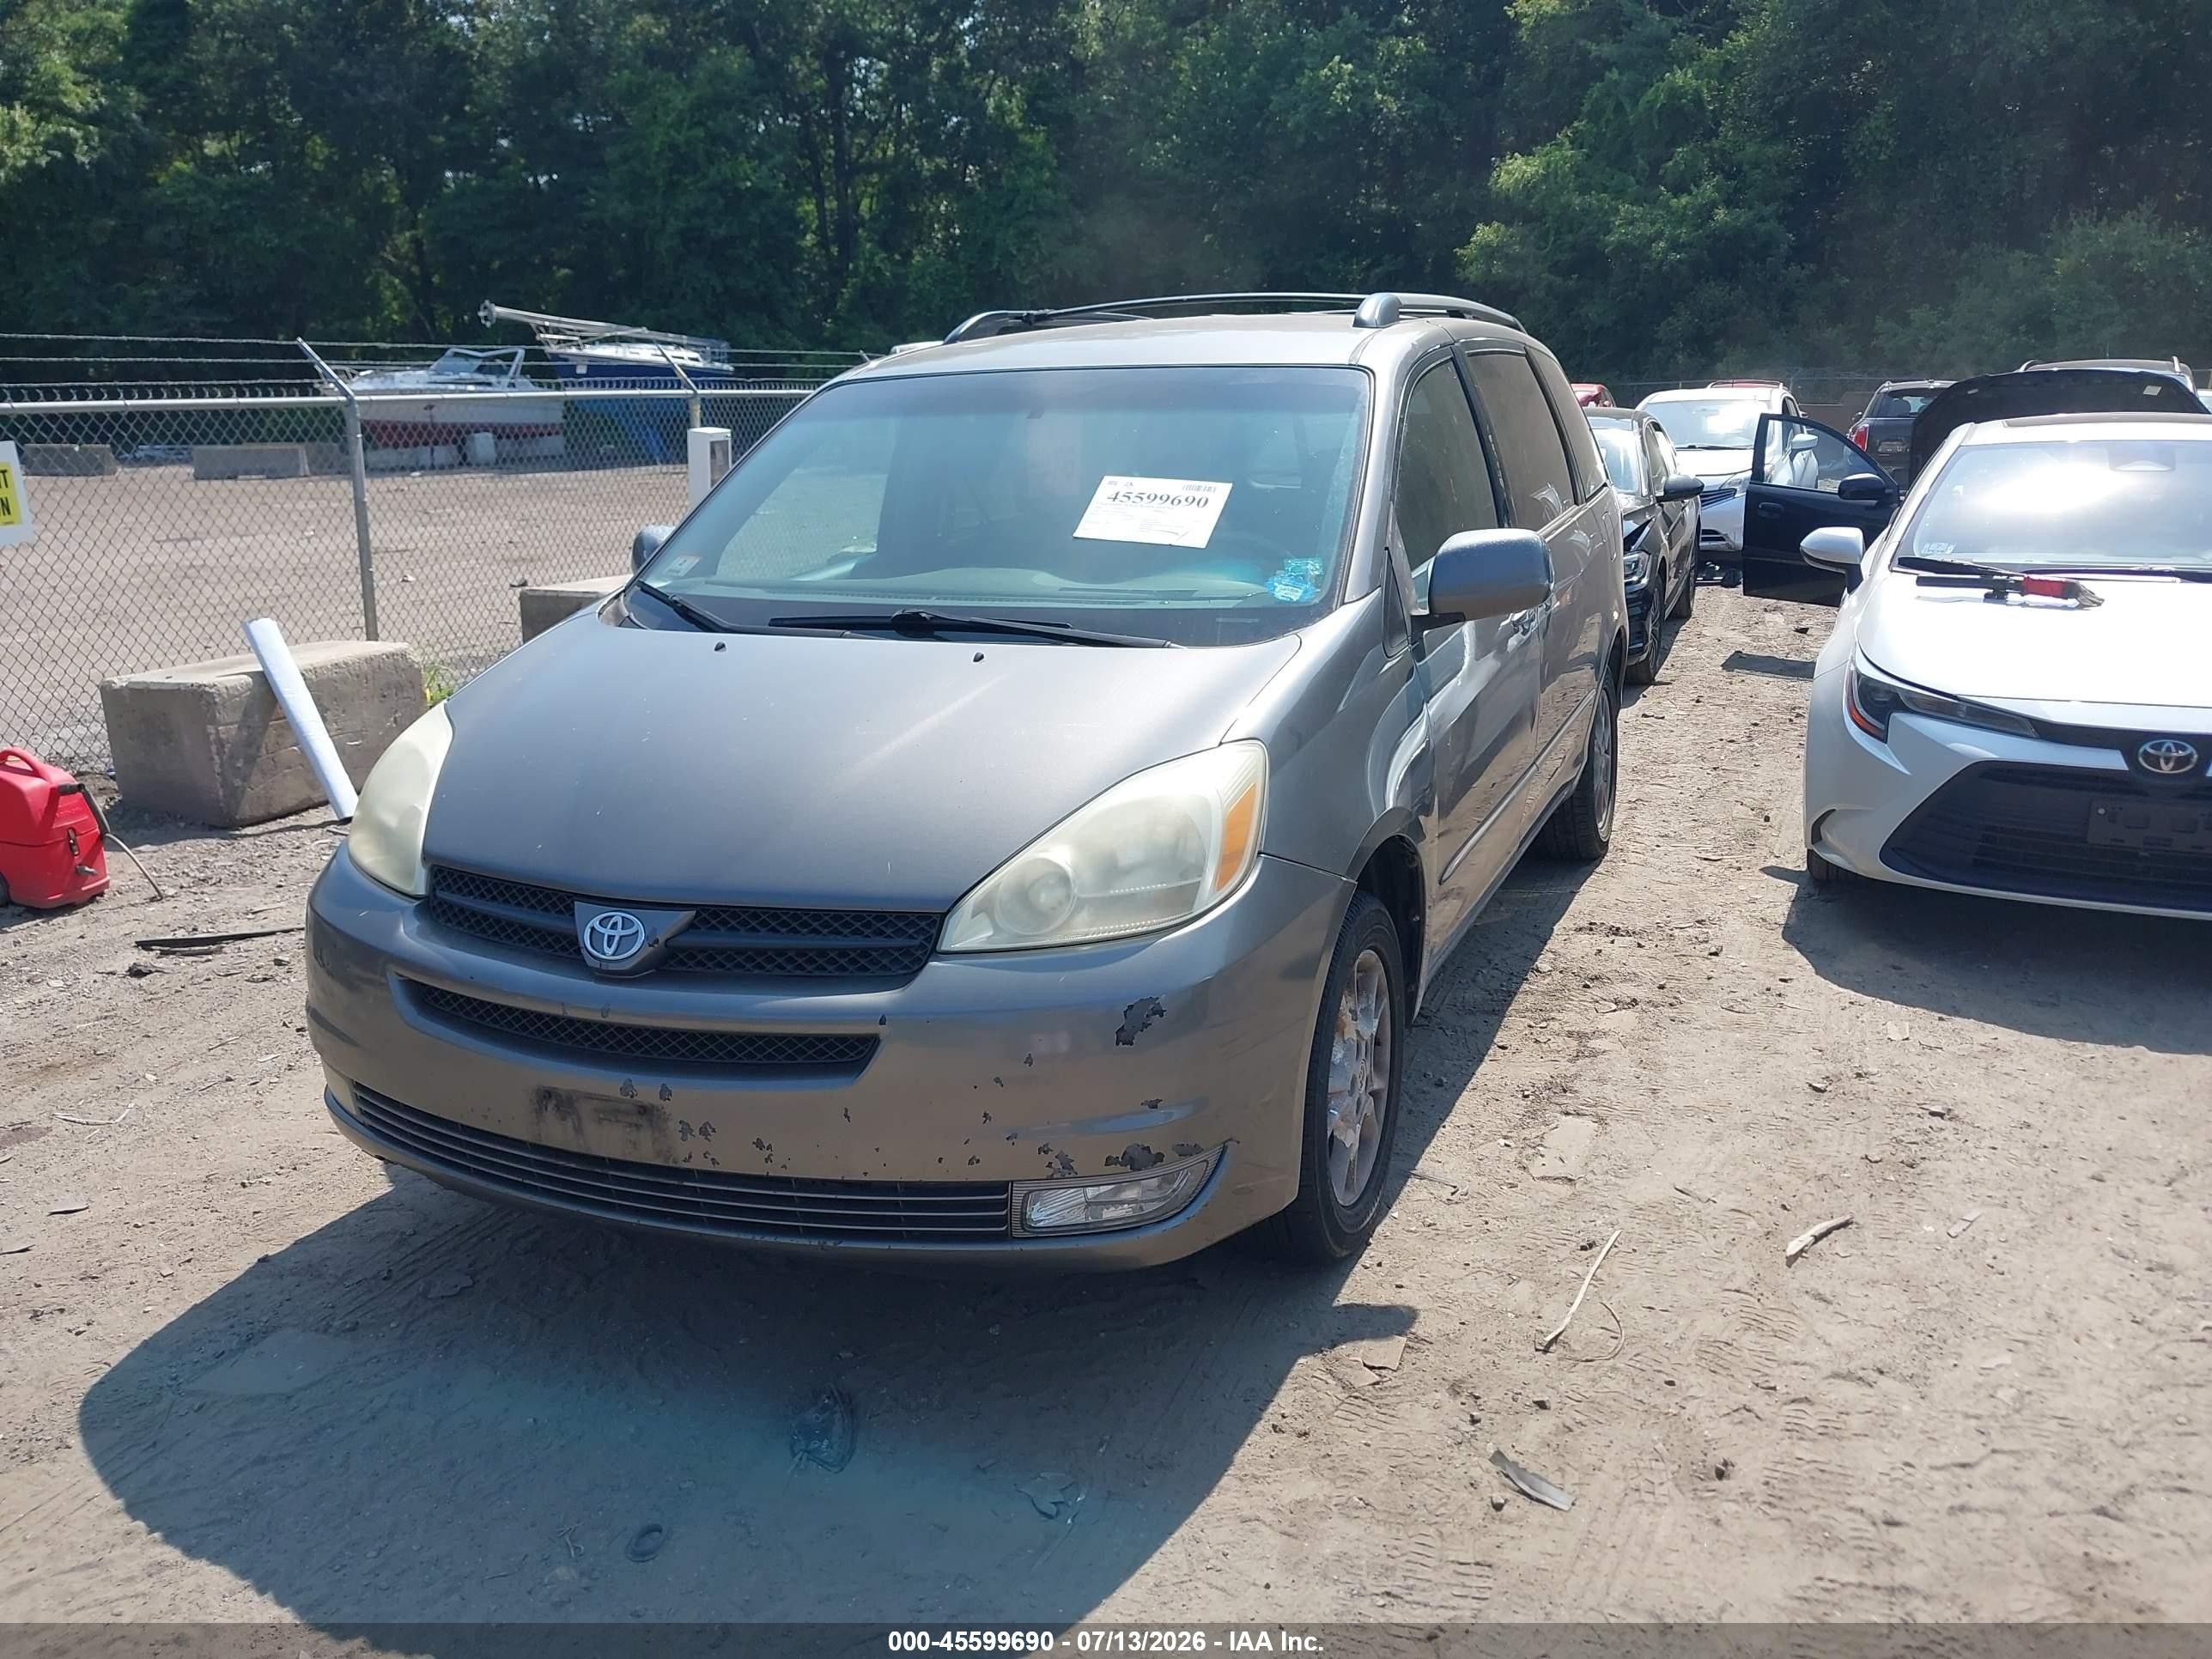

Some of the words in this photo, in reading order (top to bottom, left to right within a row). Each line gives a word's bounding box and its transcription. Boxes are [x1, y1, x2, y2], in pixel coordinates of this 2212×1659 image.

[0, 469, 9, 489] T
[0, 496, 11, 516] N
[1107, 490, 1209, 509] 45599690
